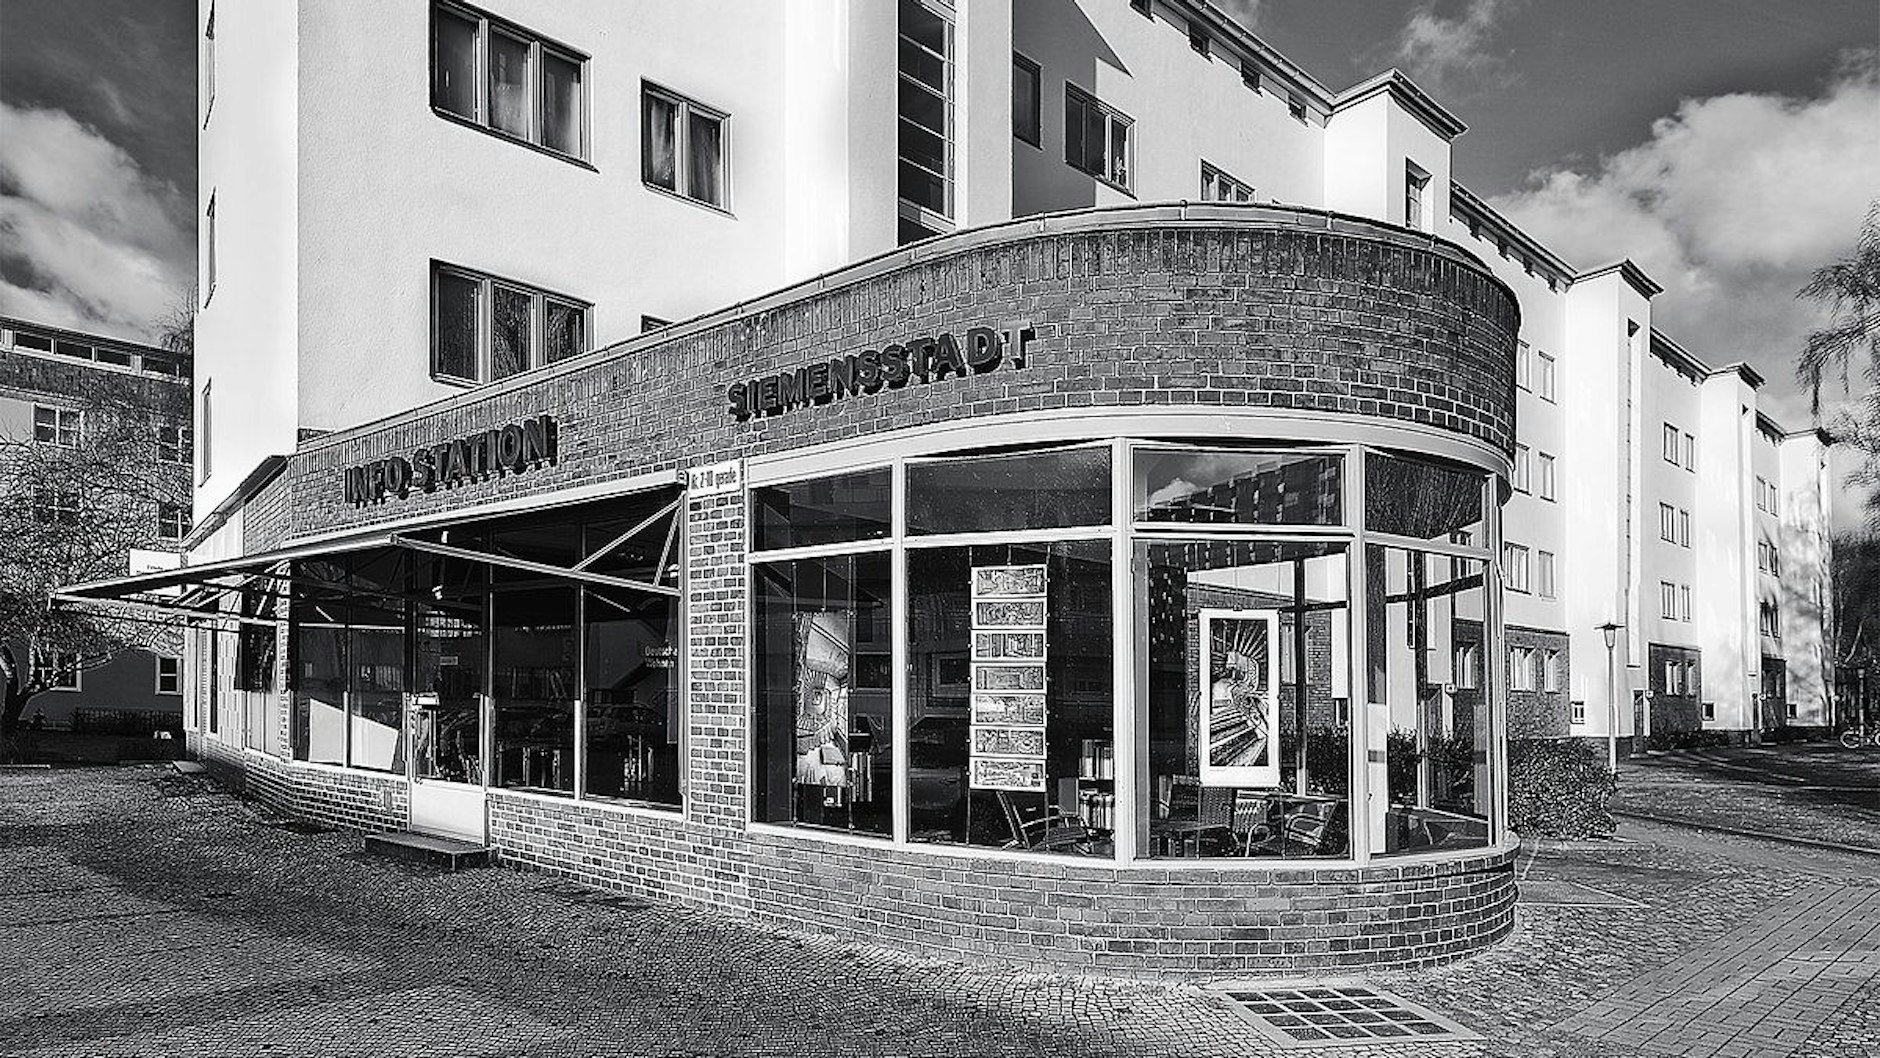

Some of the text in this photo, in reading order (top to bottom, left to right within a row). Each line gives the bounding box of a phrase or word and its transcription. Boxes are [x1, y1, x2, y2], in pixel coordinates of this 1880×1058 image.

[728, 322, 1033, 420] SIEMENSSTADT
[345, 414, 557, 503] INFO STATION
